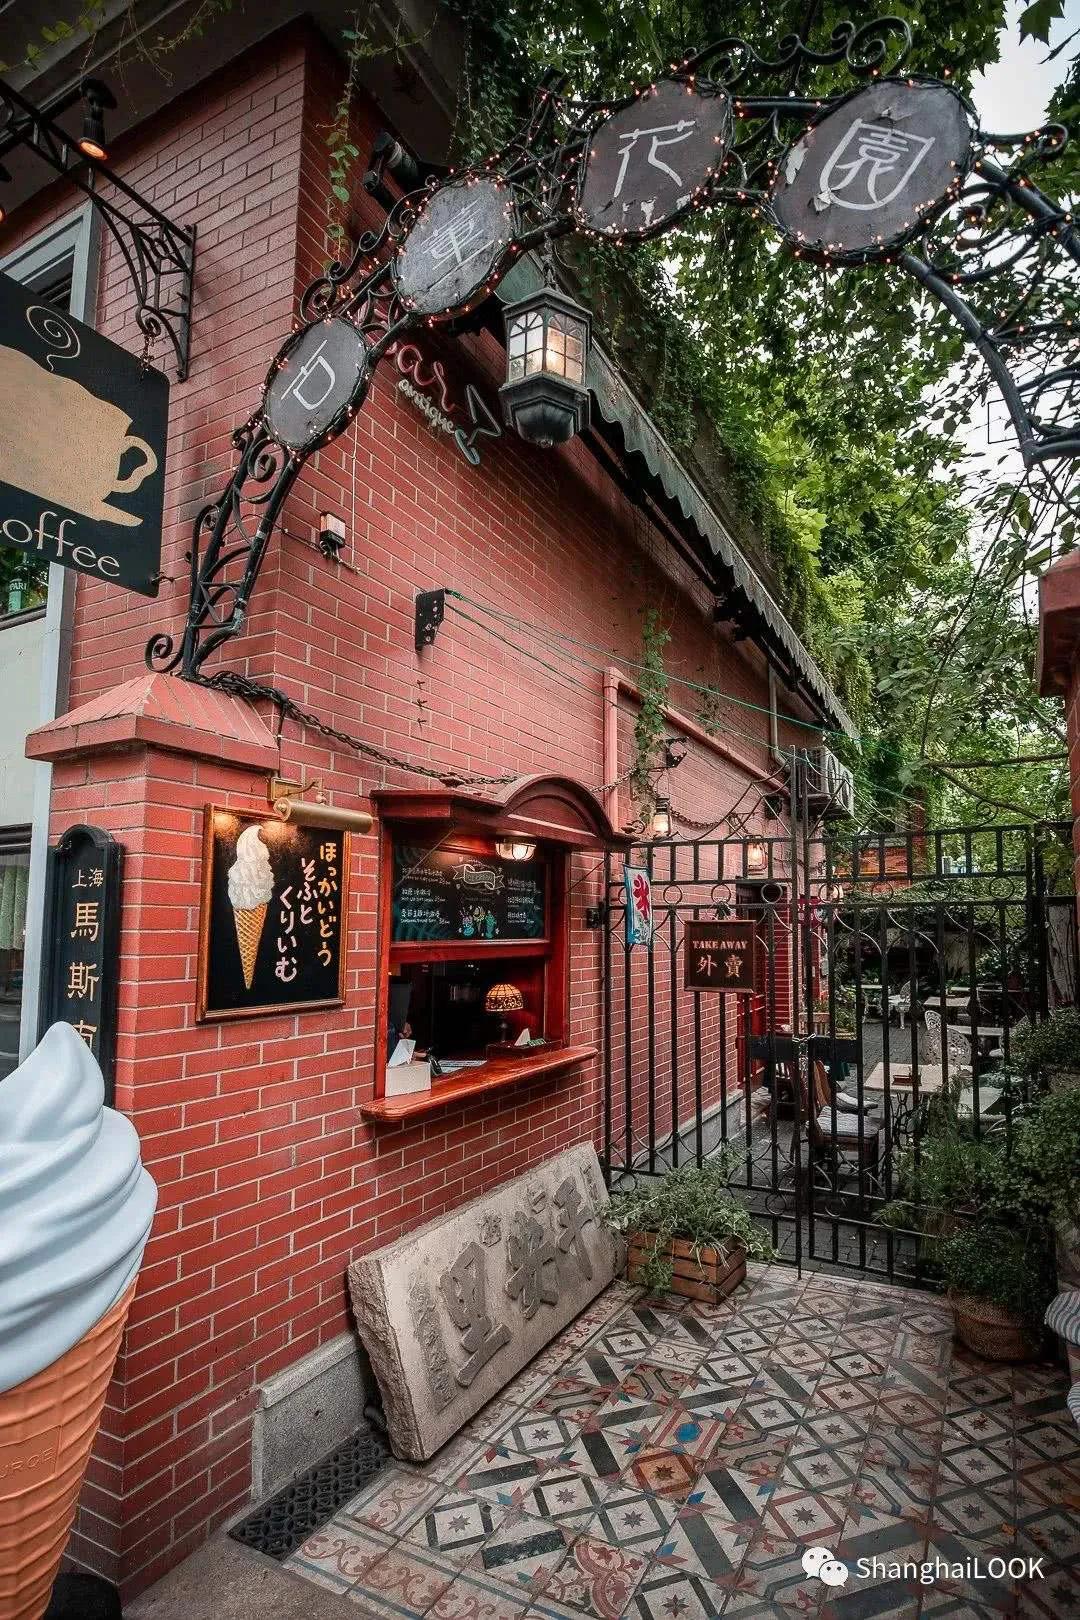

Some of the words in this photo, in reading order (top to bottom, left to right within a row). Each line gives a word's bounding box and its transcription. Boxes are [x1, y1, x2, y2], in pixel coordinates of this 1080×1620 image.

[0, 511, 120, 577] offee
[71, 868, 104, 888] 上海
[296, 857, 318, 925] そふと
[317, 842, 338, 967] ほっかいどう
[274, 885, 298, 983] くりいむ
[692, 940, 718, 949] TAKE
[720, 940, 748, 950] AWAY
